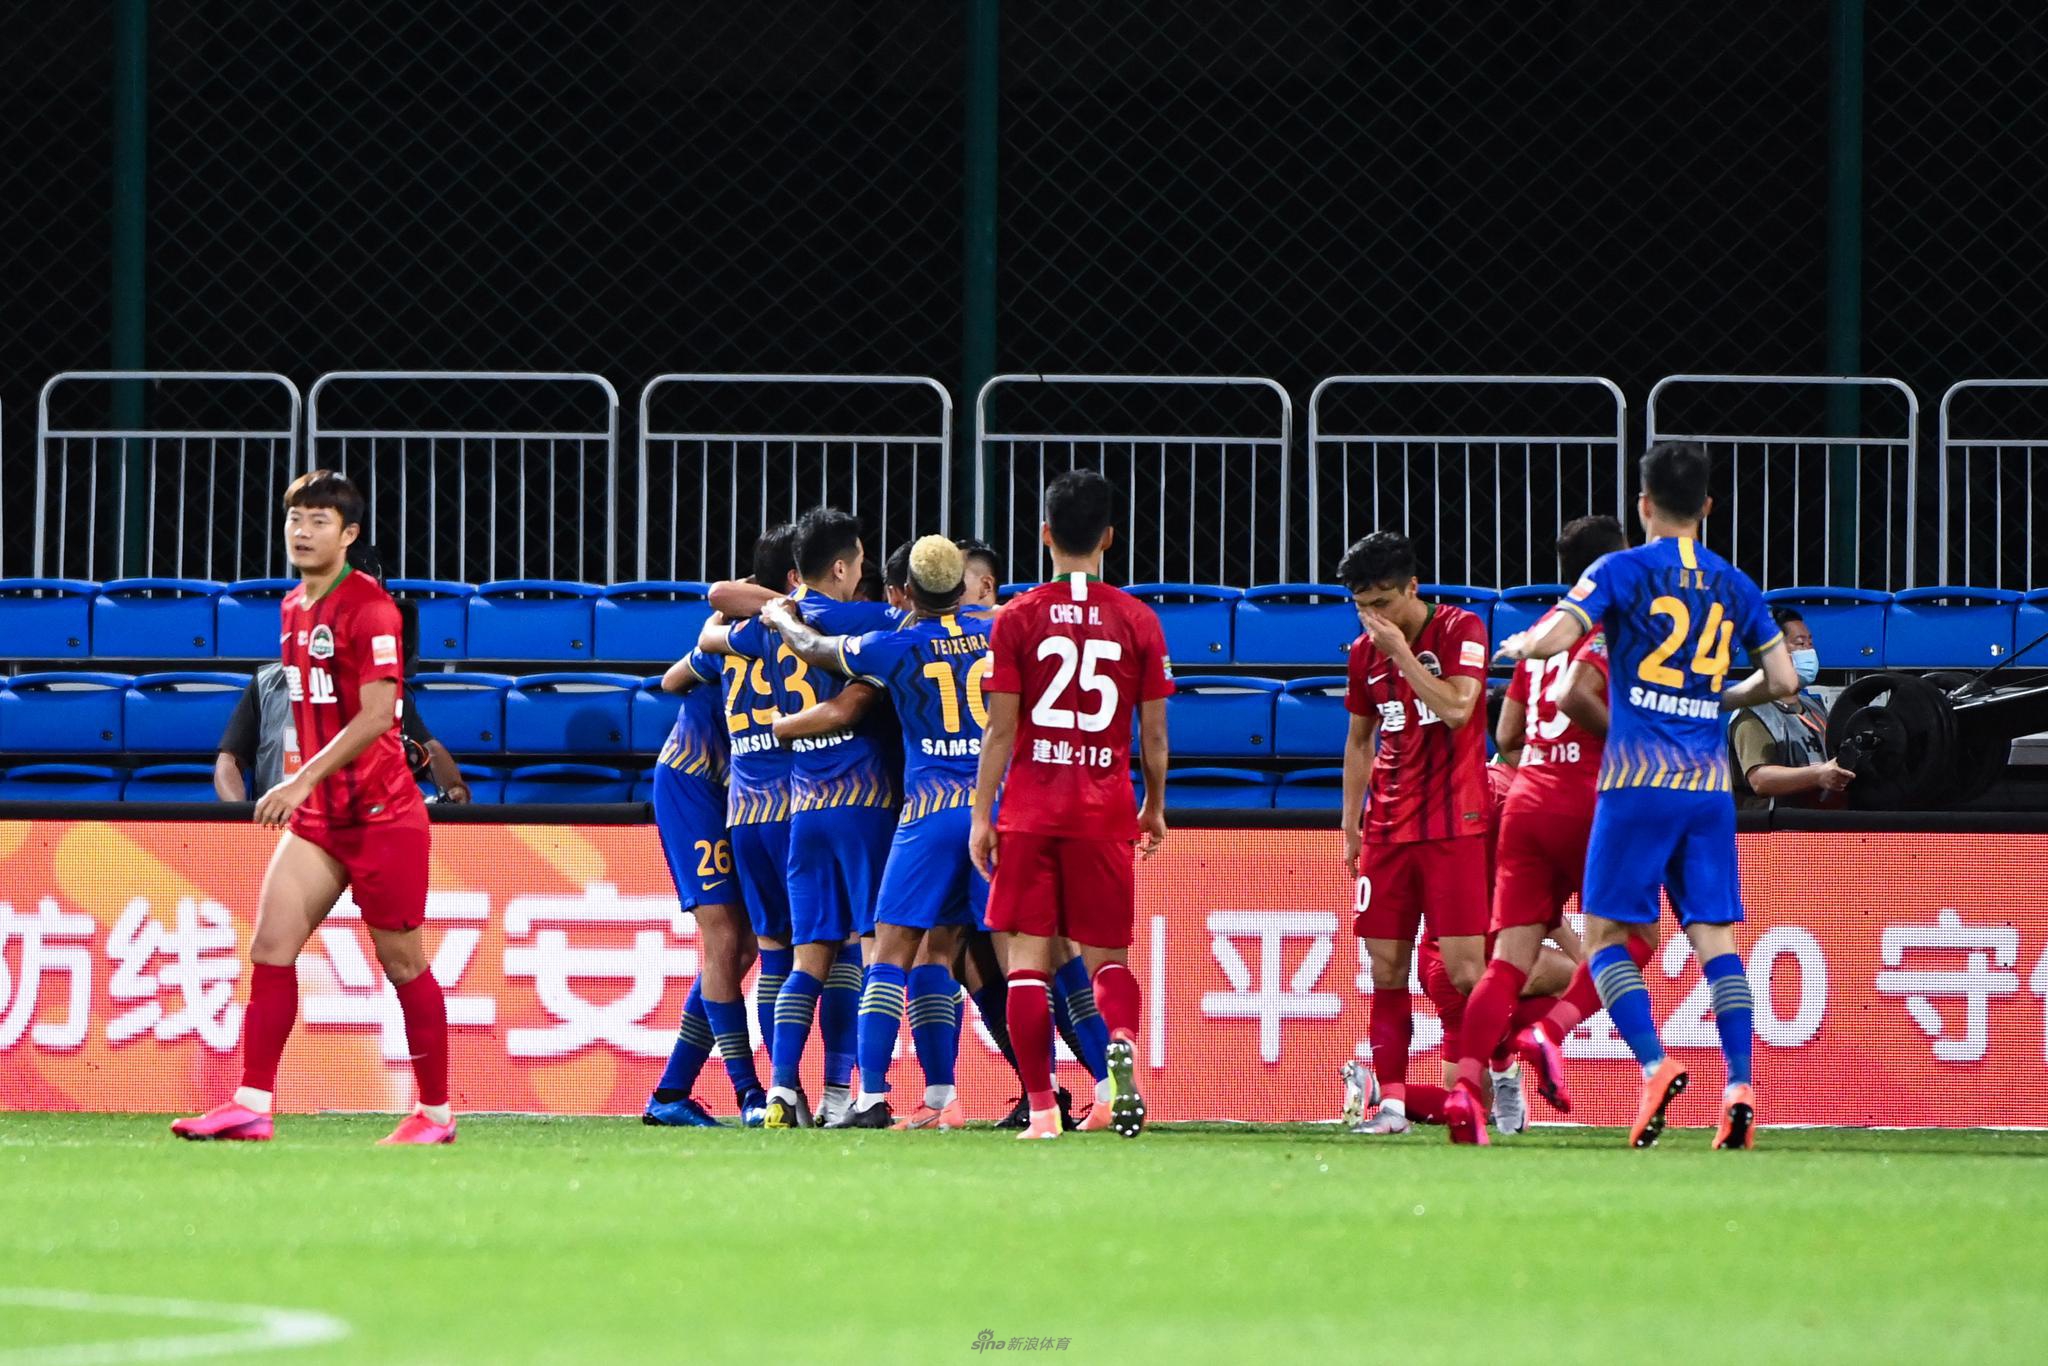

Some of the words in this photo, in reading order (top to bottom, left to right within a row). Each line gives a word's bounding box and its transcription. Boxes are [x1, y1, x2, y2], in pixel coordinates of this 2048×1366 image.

[930, 633, 990, 656] TEIXEIRA
[1050, 603, 1083, 625] CHEN
[1637, 595, 1734, 693] 24
[1031, 635, 1122, 732] 25
[1524, 650, 1571, 740] 13
[694, 839, 731, 876] 26
